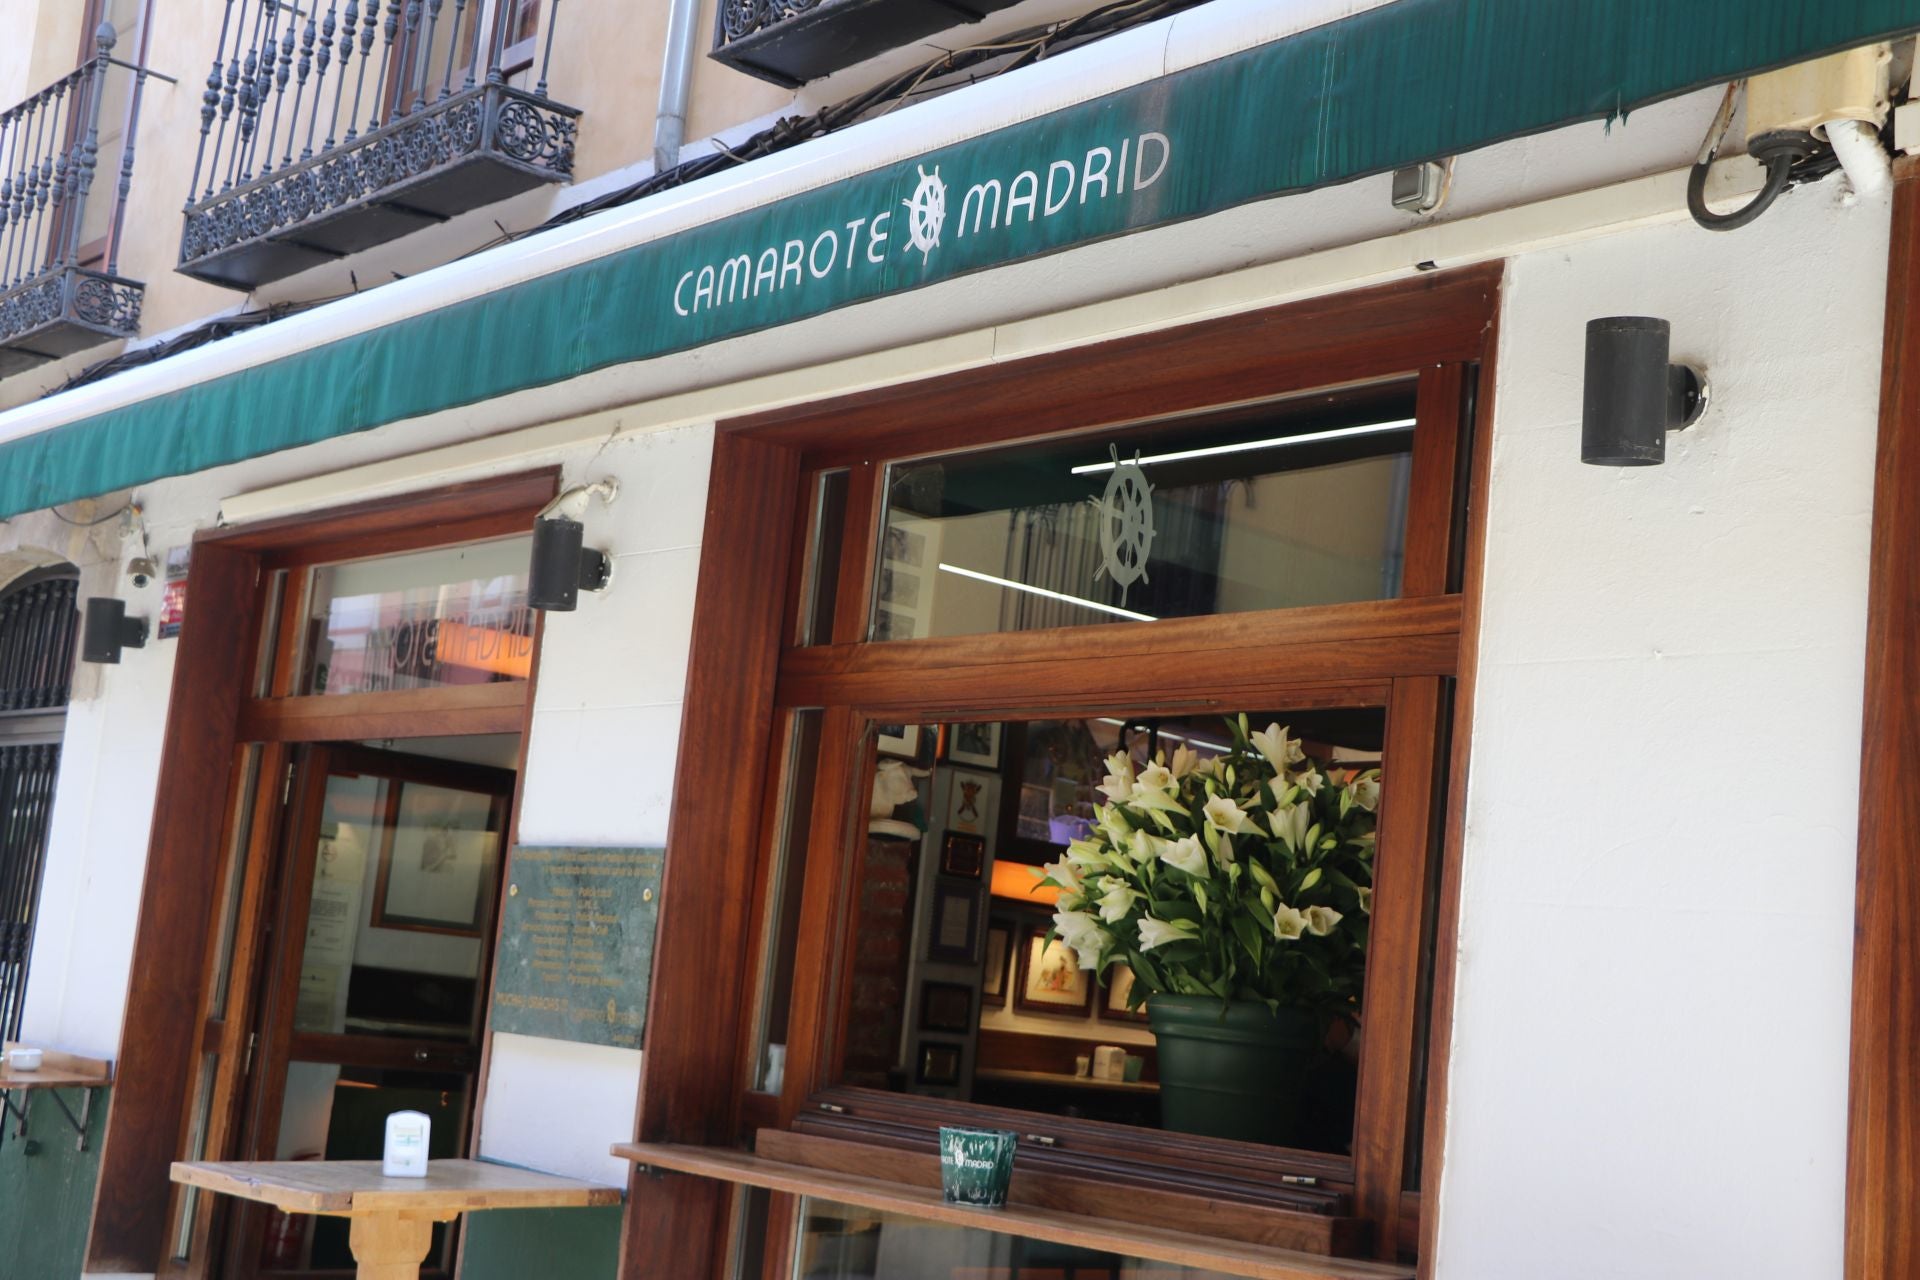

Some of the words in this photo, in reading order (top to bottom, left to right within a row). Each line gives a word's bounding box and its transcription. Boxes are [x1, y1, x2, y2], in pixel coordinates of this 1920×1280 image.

[674, 210, 891, 317] CAMAROTE
[957, 131, 1170, 239] MADRID
[965, 1158, 994, 1169] MADRID
